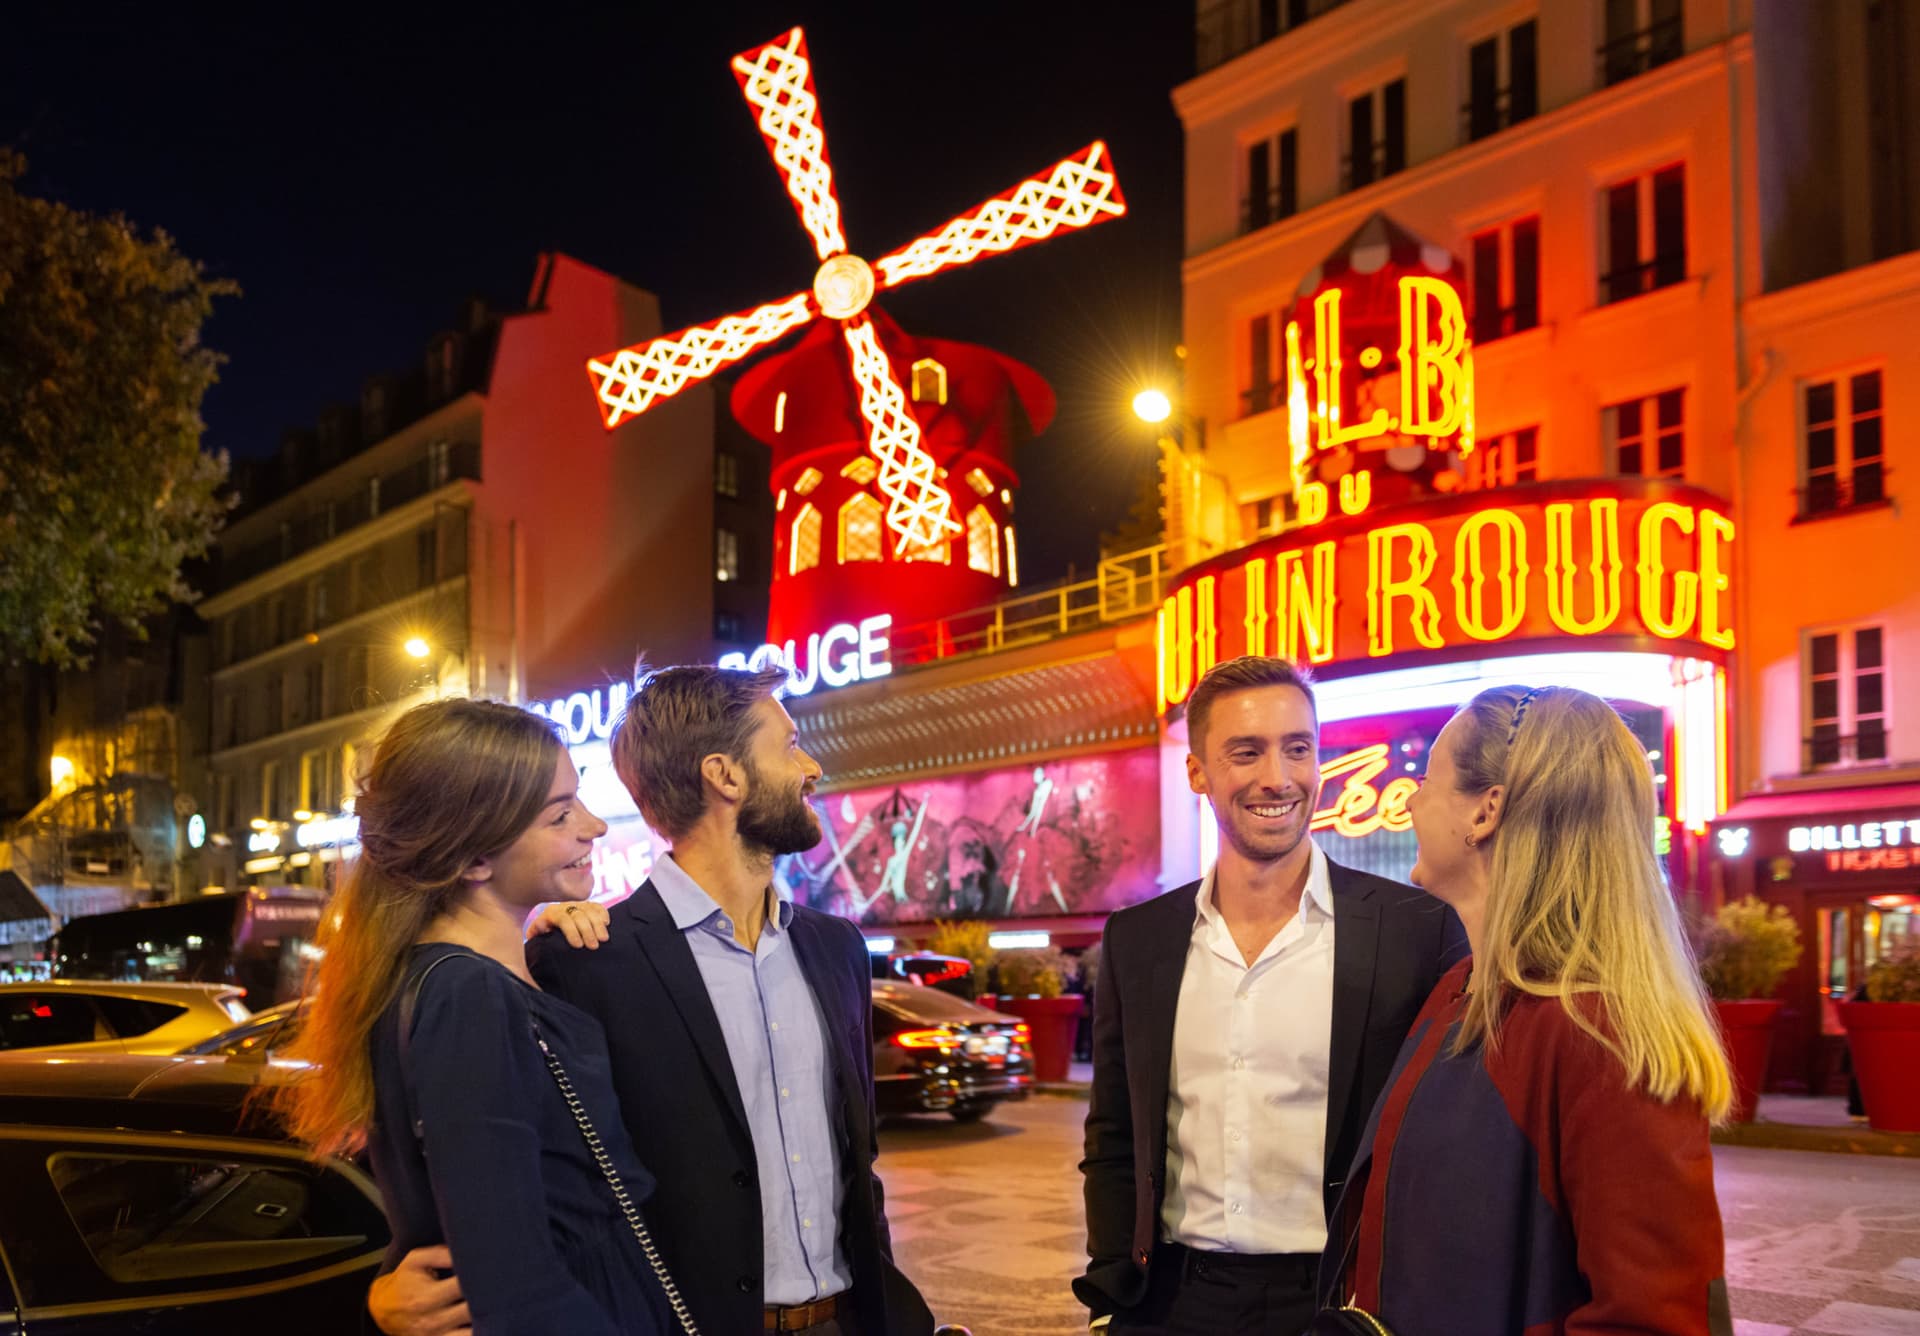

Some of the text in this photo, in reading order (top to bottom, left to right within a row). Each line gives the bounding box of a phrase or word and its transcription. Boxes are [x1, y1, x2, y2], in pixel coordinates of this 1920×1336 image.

[1299, 470, 1371, 525] DU
[1366, 497, 1735, 658] ROUGE
[1789, 819, 1920, 851] BILLETT
